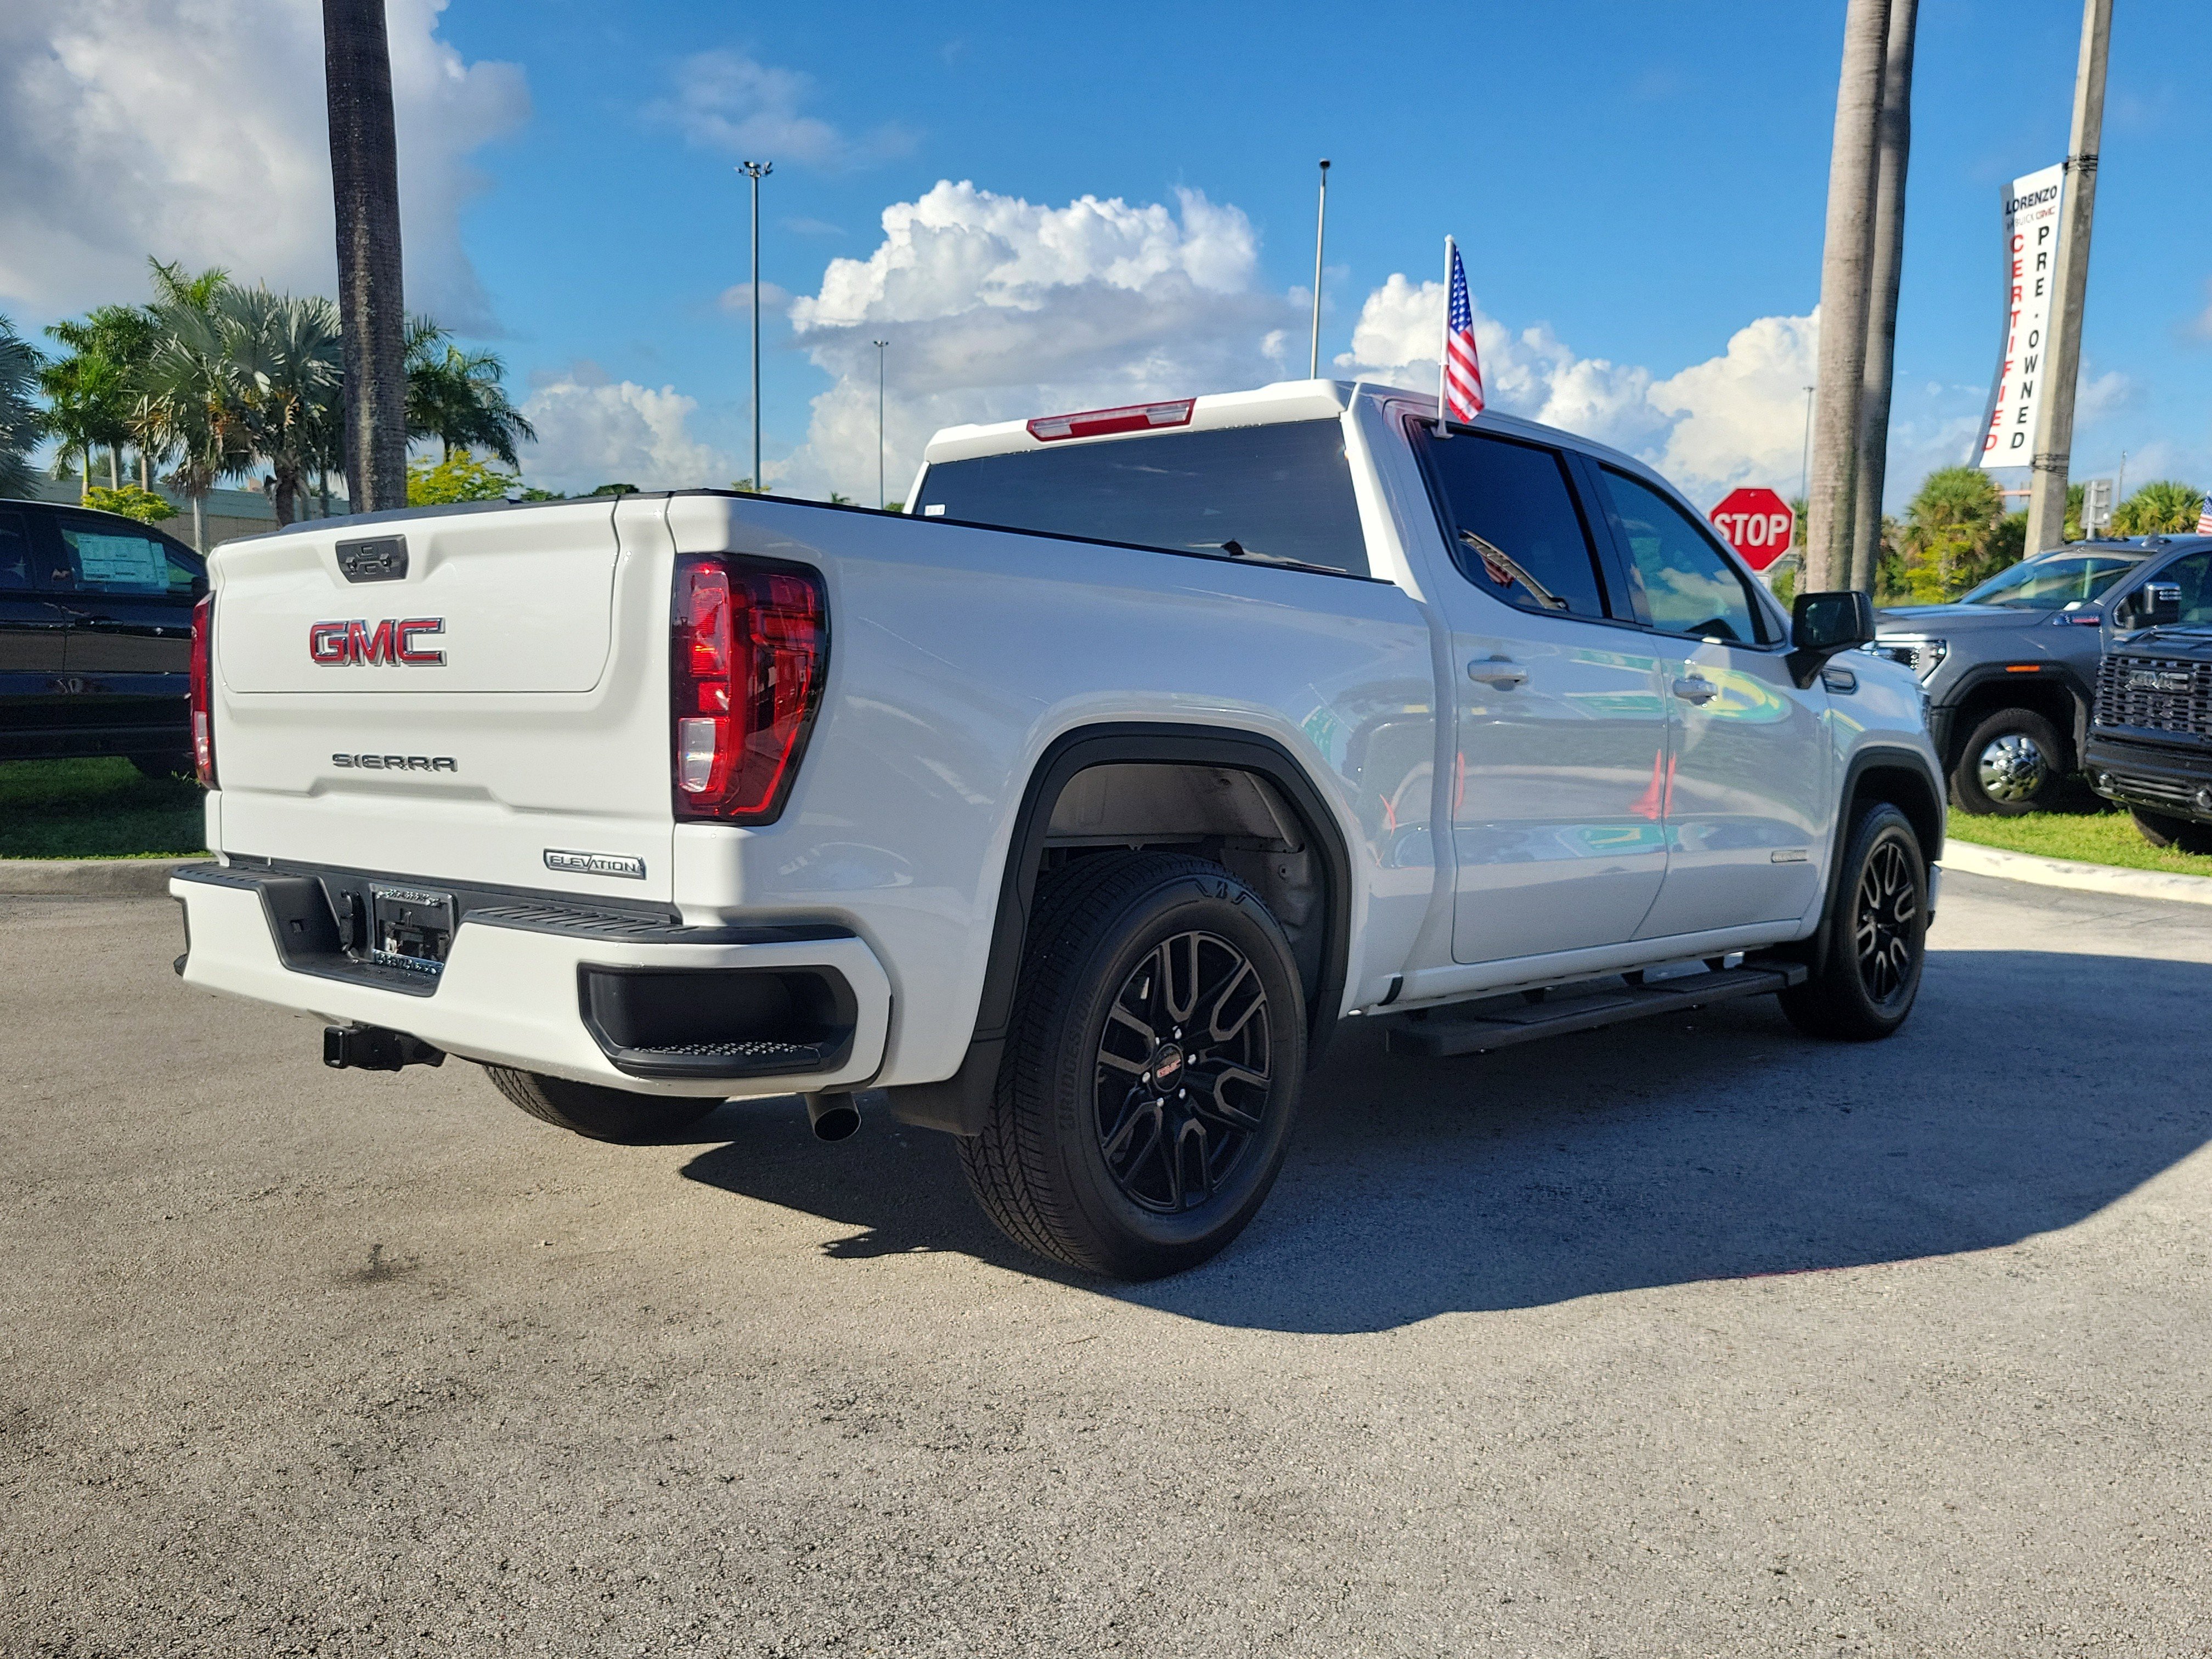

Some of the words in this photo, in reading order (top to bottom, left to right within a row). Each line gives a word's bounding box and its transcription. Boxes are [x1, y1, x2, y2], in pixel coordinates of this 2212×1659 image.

[2005, 185, 2057, 215] LORENZO
[2036, 206, 2056, 219] GMC
[1982, 234, 2023, 451] CERTIFIED
[1714, 512, 1790, 546] STOP
[309, 618, 447, 667] GMC
[332, 753, 458, 772] SIERRA
[550, 855, 636, 872] ELEVATION
